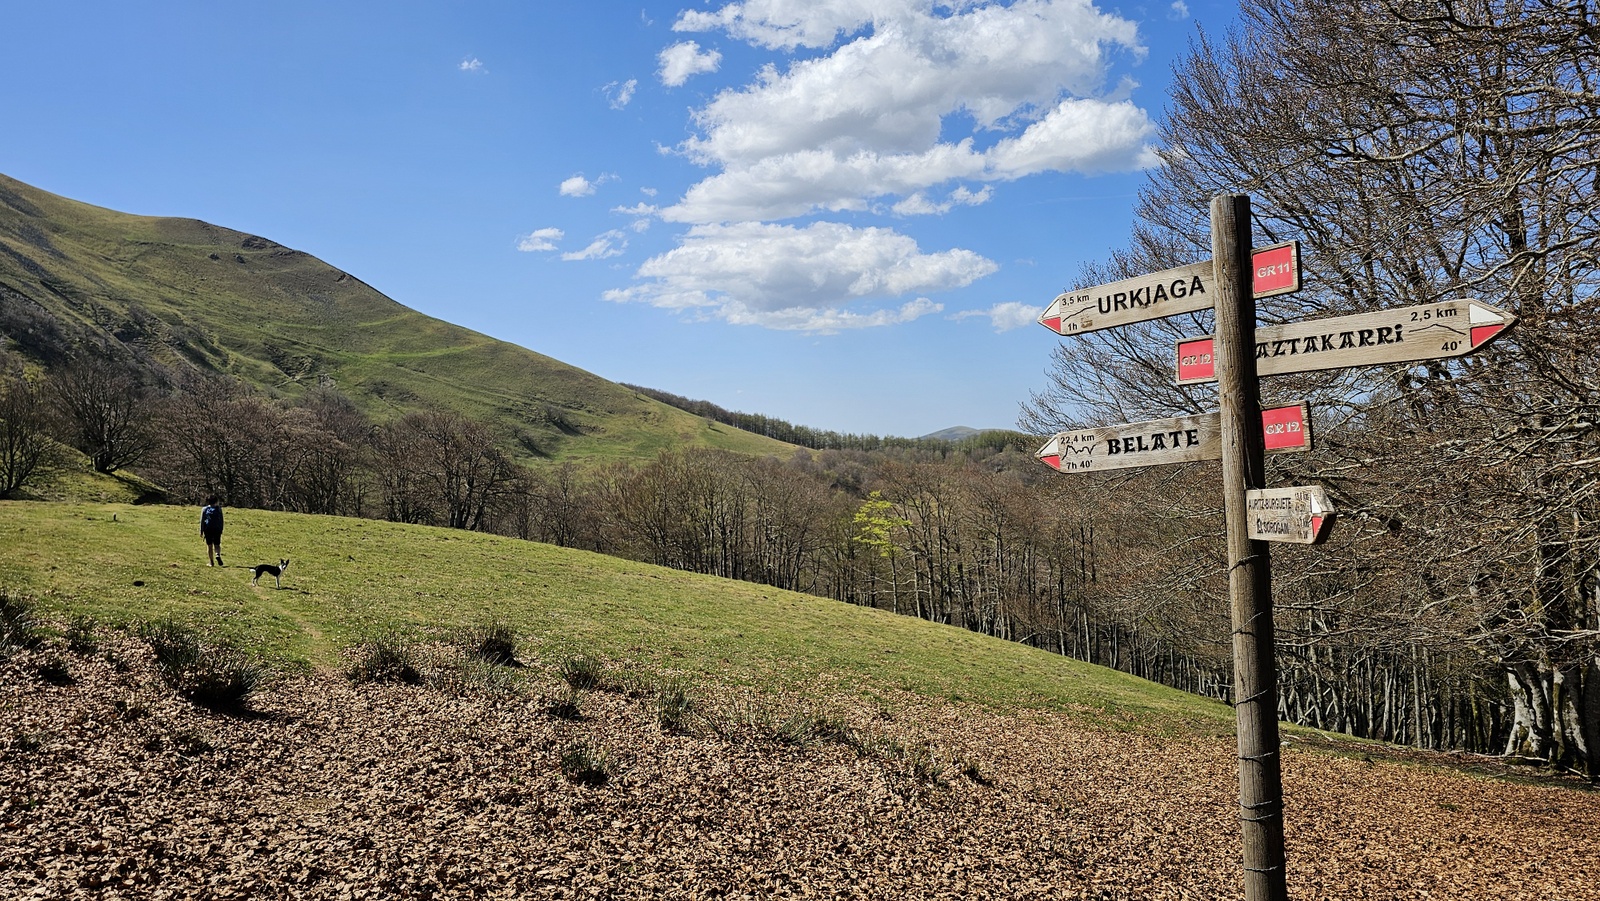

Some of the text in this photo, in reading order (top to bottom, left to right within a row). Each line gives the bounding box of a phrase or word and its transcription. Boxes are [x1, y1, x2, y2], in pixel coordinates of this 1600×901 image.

[1061, 294, 1090, 306] 3,5 km
[1410, 308, 1457, 323] 2,5 km
[1067, 322, 1078, 331] 1h
[1441, 340, 1462, 351] 40'
[1060, 435, 1079, 445] 22,4
[1107, 428, 1199, 456] BELATE
[1066, 459, 1093, 470] 7h 40'
